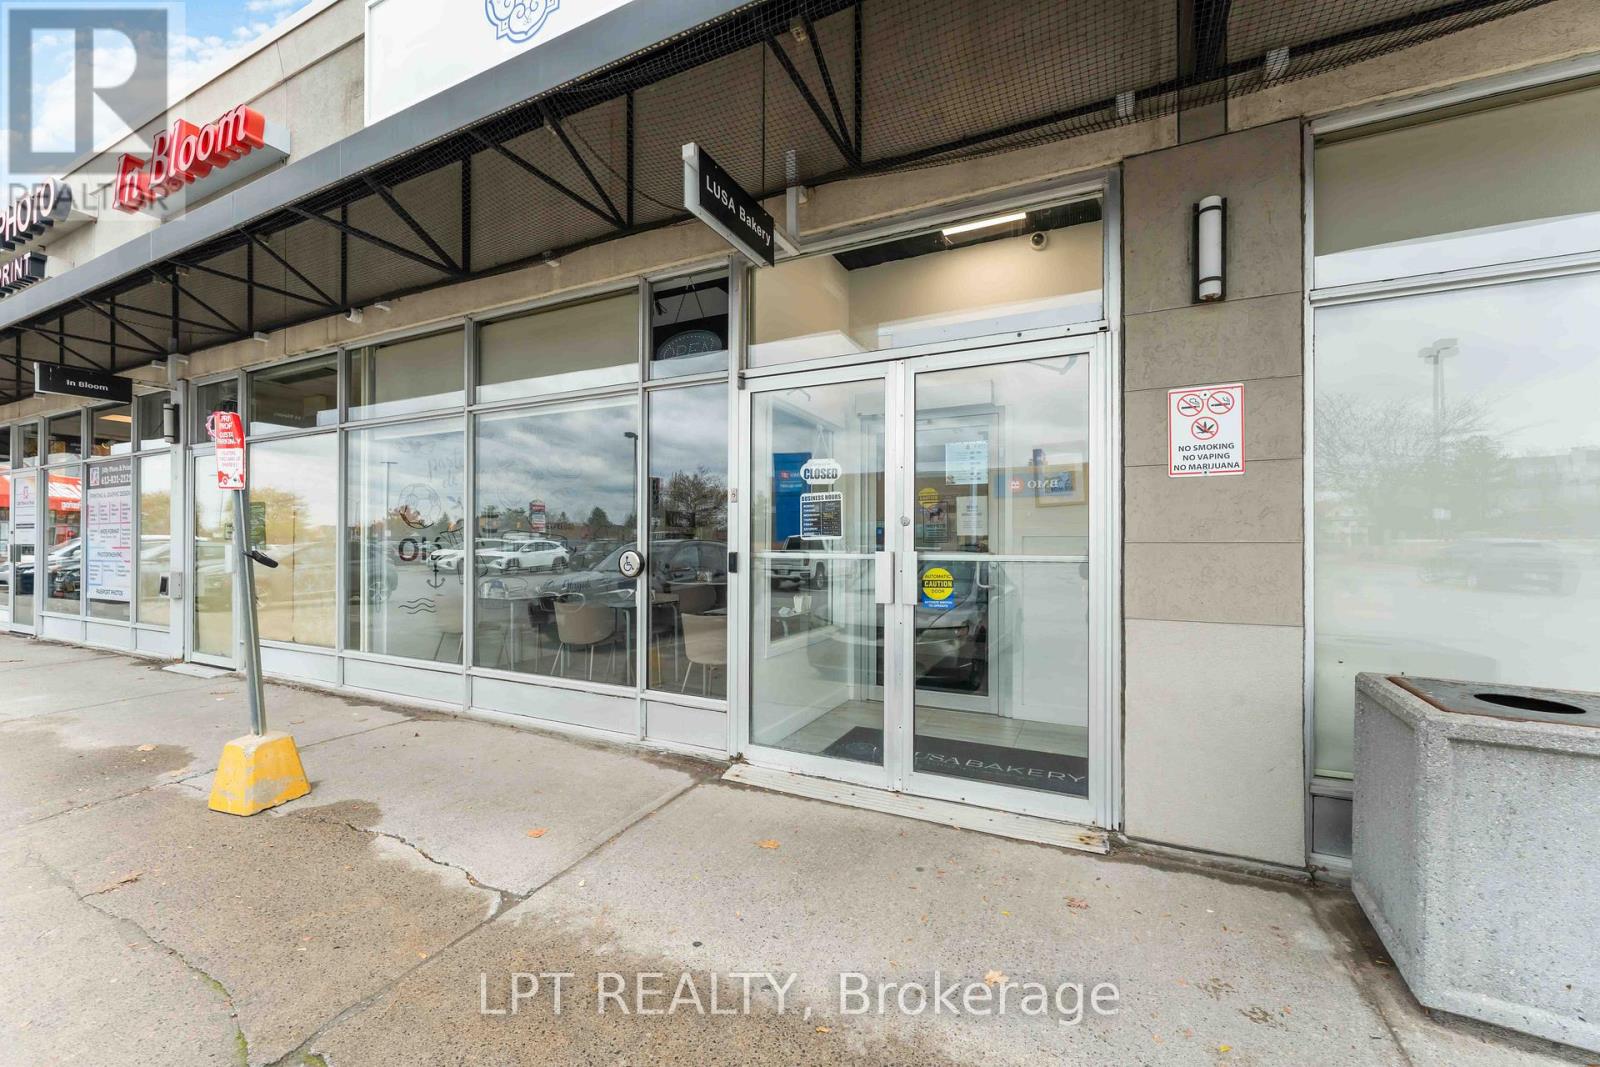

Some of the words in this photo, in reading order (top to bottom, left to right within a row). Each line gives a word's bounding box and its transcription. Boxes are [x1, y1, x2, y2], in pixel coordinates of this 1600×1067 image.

[112, 153, 143, 209] In
[149, 103, 247, 189] Bloom
[706, 174, 736, 214] LUSA
[739, 205, 771, 246] Bakery
[0, 252, 31, 287] RINT
[78, 381, 109, 391] Bloom
[1193, 442, 1235, 451] SMOKING
[1197, 452, 1230, 460] VAPING
[1188, 461, 1240, 471] MARIJUANA
[803, 468, 838, 480] CLOSED
[825, 493, 842, 501] HOURS
